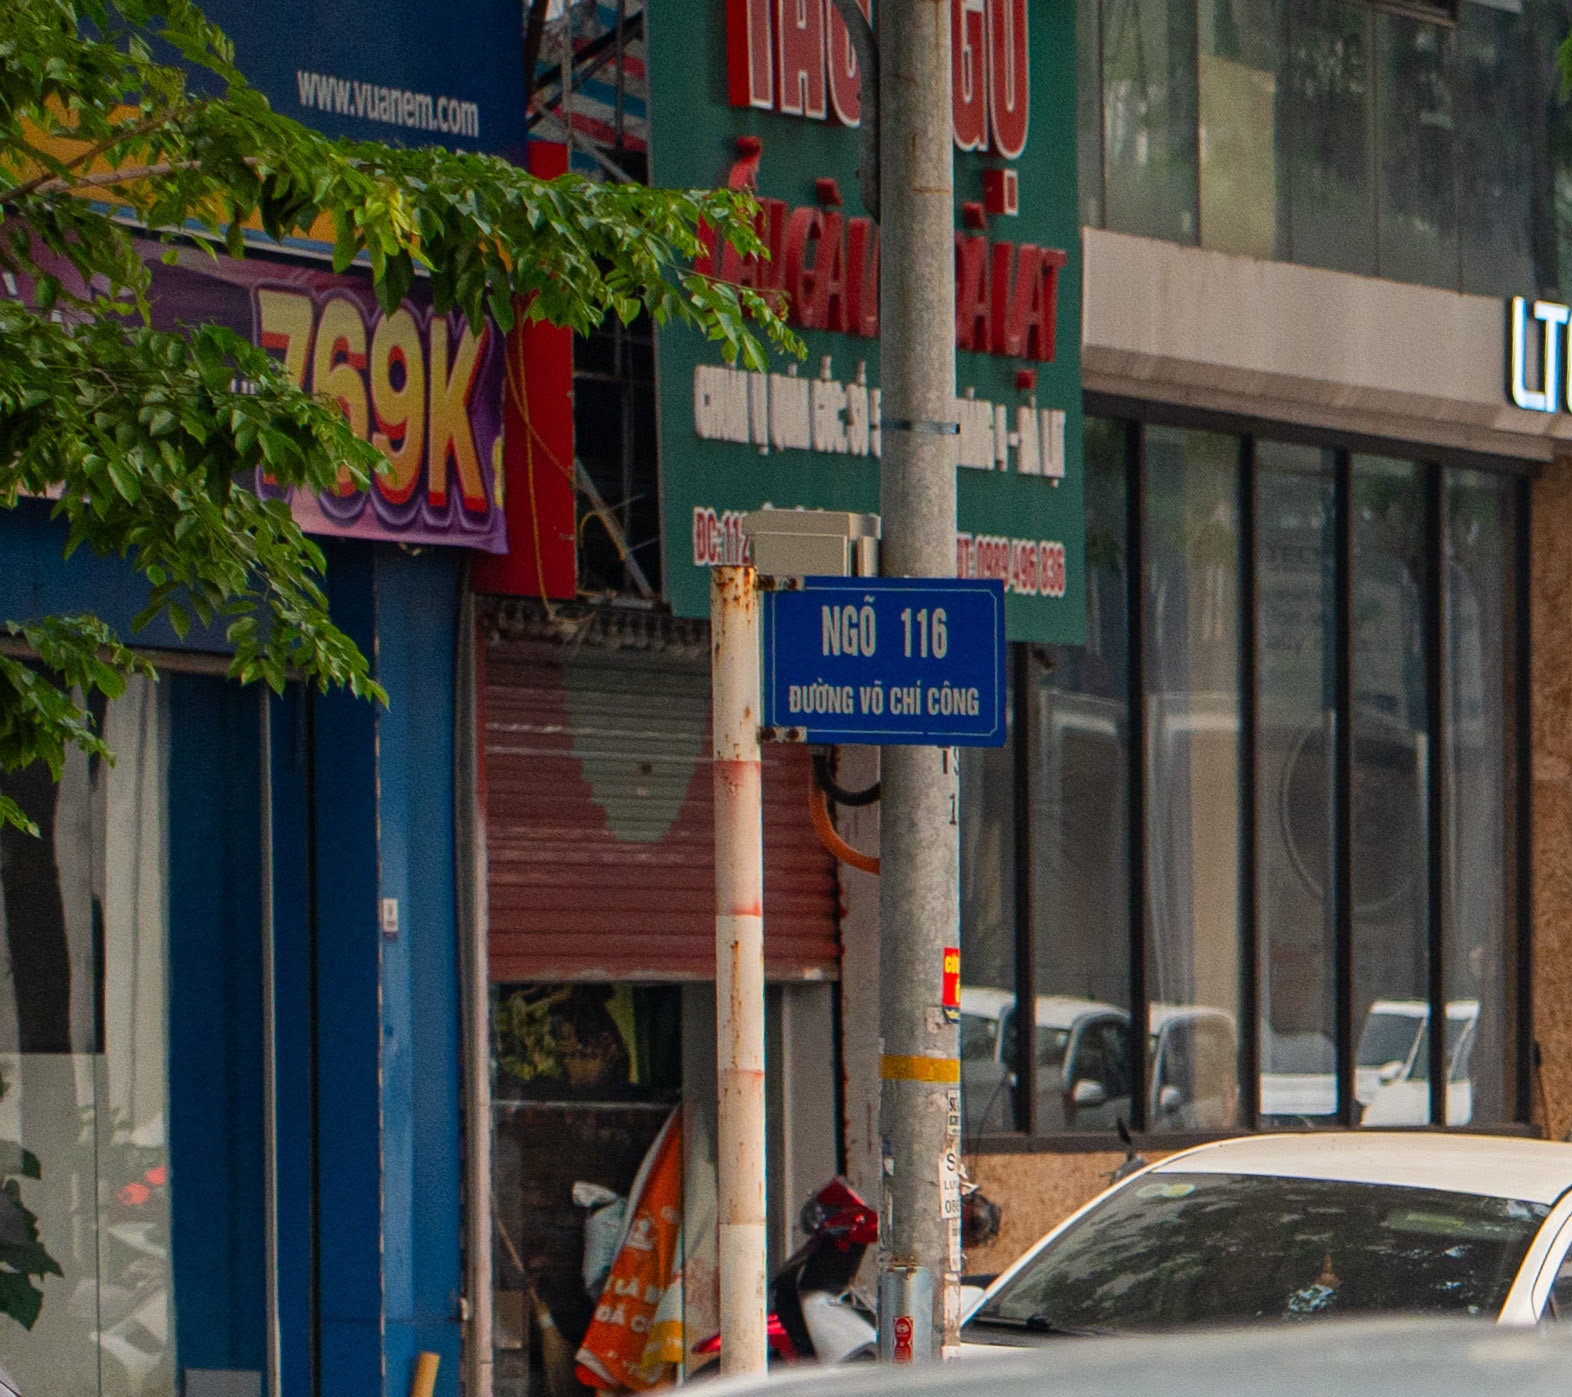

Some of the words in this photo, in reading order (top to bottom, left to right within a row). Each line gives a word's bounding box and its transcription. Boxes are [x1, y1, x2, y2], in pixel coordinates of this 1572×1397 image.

[297, 69, 479, 138] www.vuanem.com
[821, 594, 877, 657] NGÕ
[900, 607, 948, 660] 116
[788, 677, 854, 715] ĐƯỜNG
[859, 680, 884, 716] VÕ
[889, 679, 922, 716] CHÍ
[926, 681, 980, 717] CÔNG
